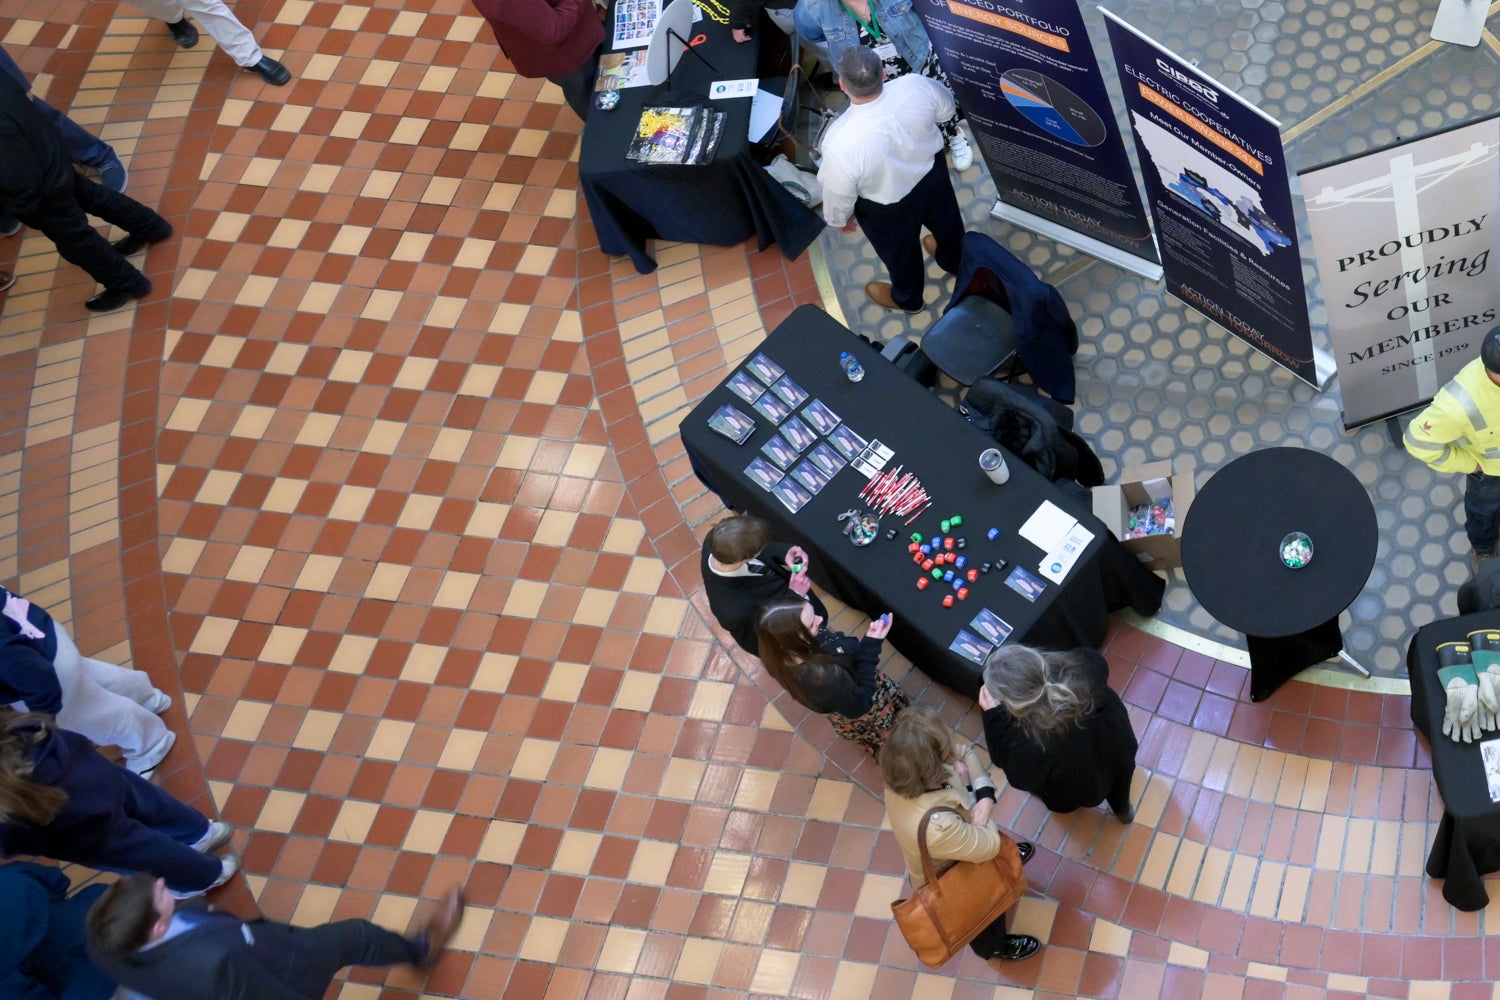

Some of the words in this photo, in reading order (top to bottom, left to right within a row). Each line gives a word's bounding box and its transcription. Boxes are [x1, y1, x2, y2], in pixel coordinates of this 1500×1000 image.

[950, 3, 1002, 25] ENERGY
[1004, 20, 1066, 48] SOURCES
[997, 5, 1070, 37] PORTFOLIO
[1155, 58, 1220, 103] CIPCO
[1124, 63, 1182, 107] ELECTRIC
[1182, 96, 1273, 165] COOPERATIVES
[1141, 88, 1184, 119] POWER
[1184, 114, 1234, 152] IOWANS
[1234, 148, 1261, 169] 24/7
[1149, 111, 1173, 128] Meet
[1173, 126, 1191, 140] Our
[1190, 137, 1262, 190] Member-Owners
[1012, 188, 1058, 211] ACTION
[1061, 206, 1101, 227] TODAY
[1157, 200, 1203, 231] Generation
[1203, 228, 1239, 254] Facilities
[1239, 250, 1248, 262] &
[1248, 256, 1292, 291] Resources
[1336, 214, 1488, 272] PROUDLY
[1345, 248, 1490, 309] Serving
[1386, 292, 1454, 321] OUR
[1181, 282, 1224, 311] ACTION
[1226, 309, 1265, 339] TODAY
[1349, 308, 1496, 365] MEMBERS
[1381, 353, 1435, 375] SINCE
[1438, 343, 1469, 358] 1939
